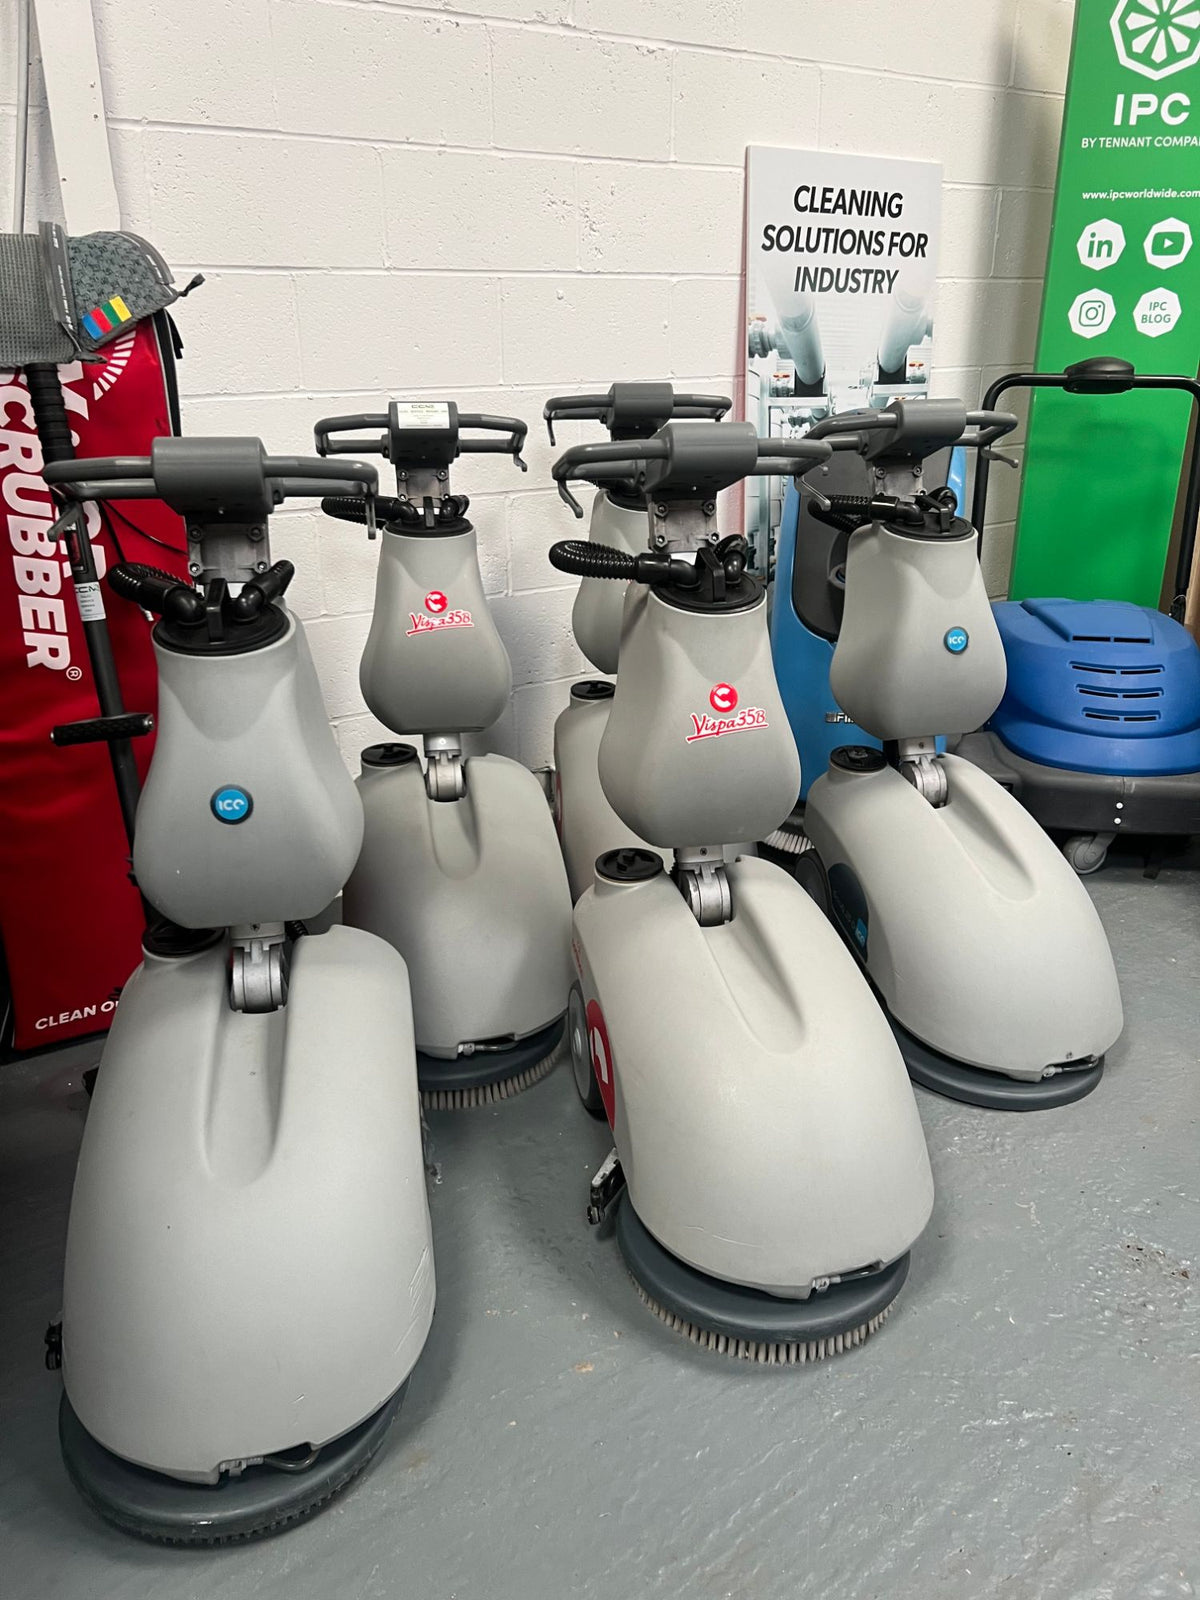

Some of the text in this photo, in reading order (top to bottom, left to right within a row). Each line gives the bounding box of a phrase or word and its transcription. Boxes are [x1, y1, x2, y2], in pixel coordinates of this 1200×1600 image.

[1113, 92, 1191, 126] IPC
[1081, 137, 1097, 149] BY
[1099, 136, 1152, 148] TENNANT
[793, 185, 903, 219] CLEANING
[1082, 188, 1200, 202] www.ipcworldwide.com
[761, 223, 929, 258] SOLUTIONS FOR
[1087, 231, 1114, 258] in
[794, 266, 899, 294] INDUSTRY
[1141, 314, 1172, 324] BLOG
[1149, 301, 1168, 311] IPC
[691, 708, 766, 736] Vispa35B
[35, 1004, 97, 1030] CLEAN
